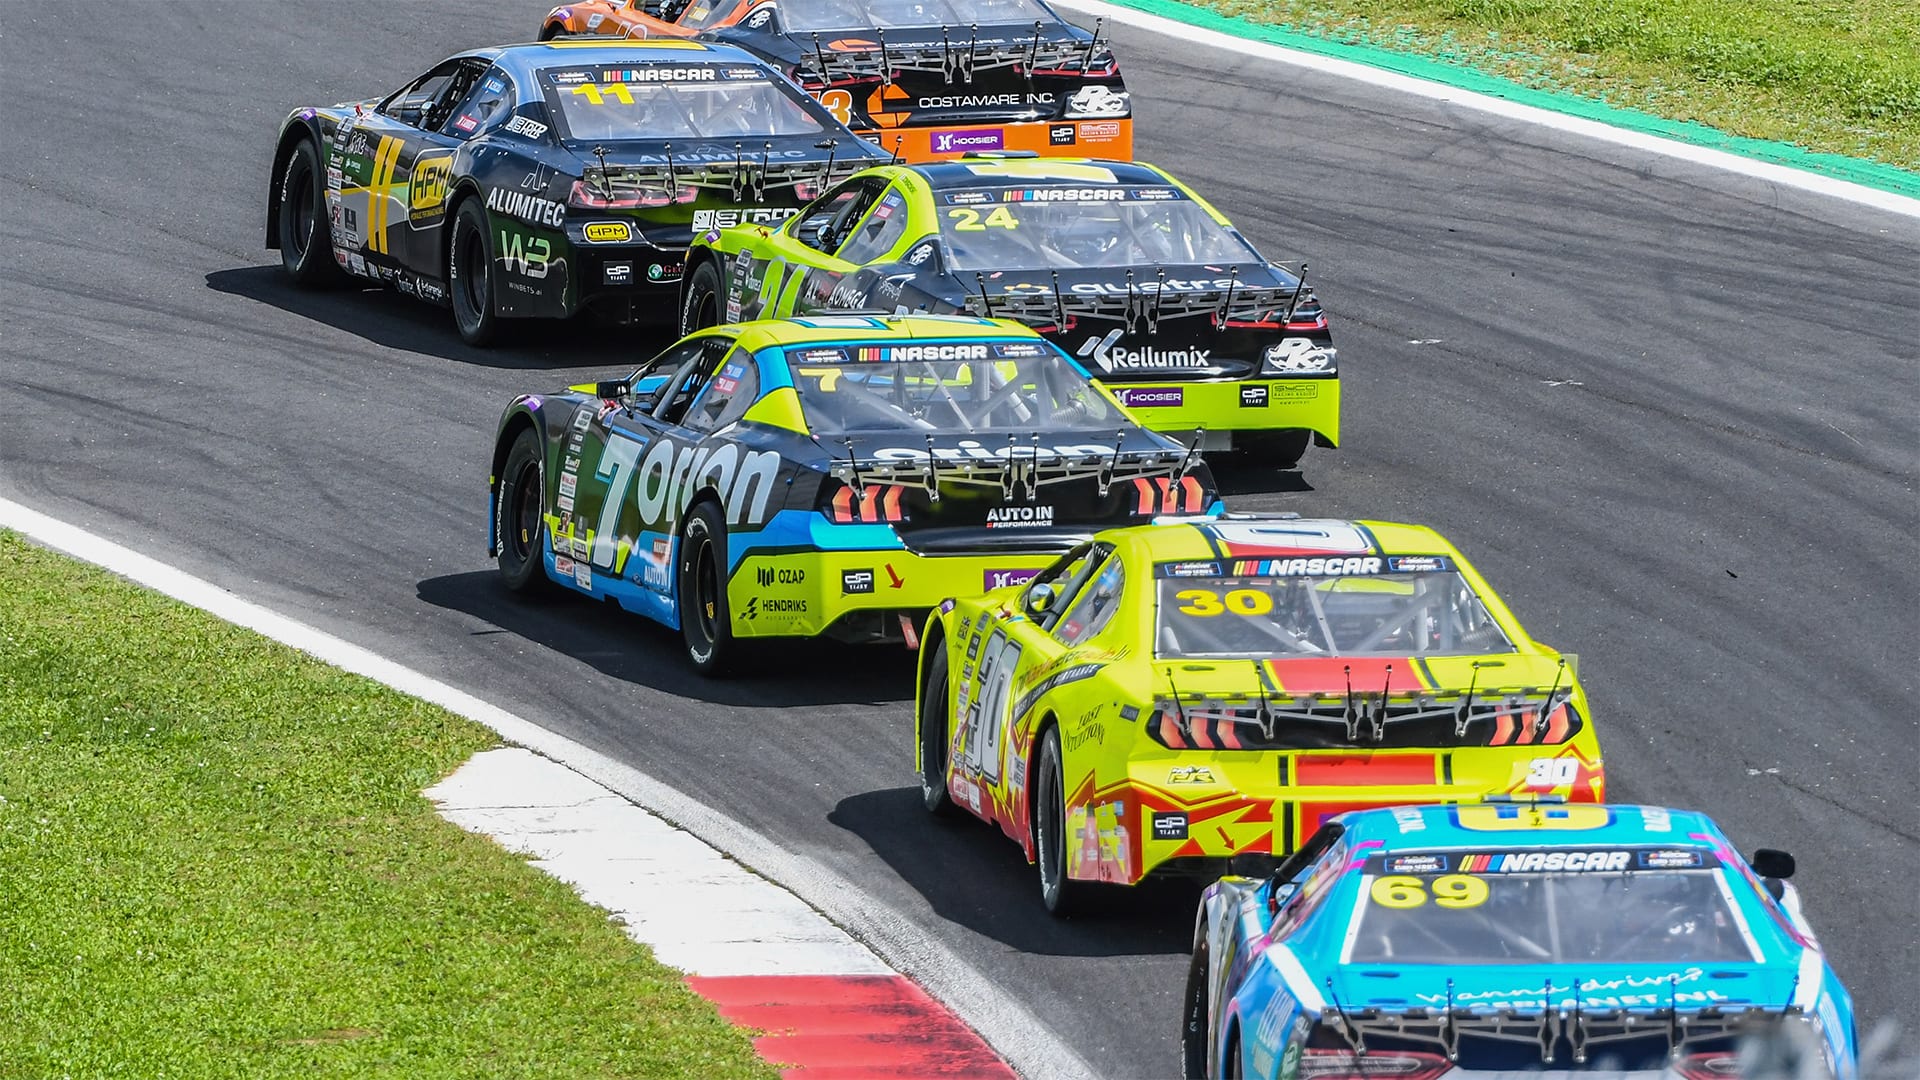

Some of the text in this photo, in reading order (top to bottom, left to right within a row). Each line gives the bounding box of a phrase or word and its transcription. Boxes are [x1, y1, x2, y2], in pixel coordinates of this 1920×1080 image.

[631, 69, 715, 82] NASCAR
[571, 83, 635, 105] 11
[919, 92, 1056, 109] COSTAMARE INC.
[812, 89, 852, 126] 3
[953, 136, 998, 146] HOOSIER
[640, 151, 806, 162] ALUMITEC
[412, 166, 448, 200] HPM
[1033, 190, 1125, 201] NASCAR
[486, 187, 565, 227] ALUMITEC
[948, 207, 1019, 231] 24
[590, 226, 626, 237] HPM
[1071, 279, 1244, 294] quatra
[890, 346, 988, 361] NASCAR
[1112, 345, 1210, 368] Rellumix
[798, 368, 842, 392] 7
[1130, 392, 1182, 402] HOOSIER
[873, 441, 1116, 460] orion
[637, 439, 781, 525] orion
[594, 425, 649, 569] 7
[986, 506, 1053, 521] AUTO IN
[1269, 557, 1381, 576] NASCAR
[778, 570, 805, 584] OZAP
[762, 600, 807, 612] HENDRIKS
[1175, 589, 1273, 616] 30
[1526, 757, 1578, 786] 30
[1501, 851, 1631, 872] NASCAR
[1371, 875, 1489, 909] 69
